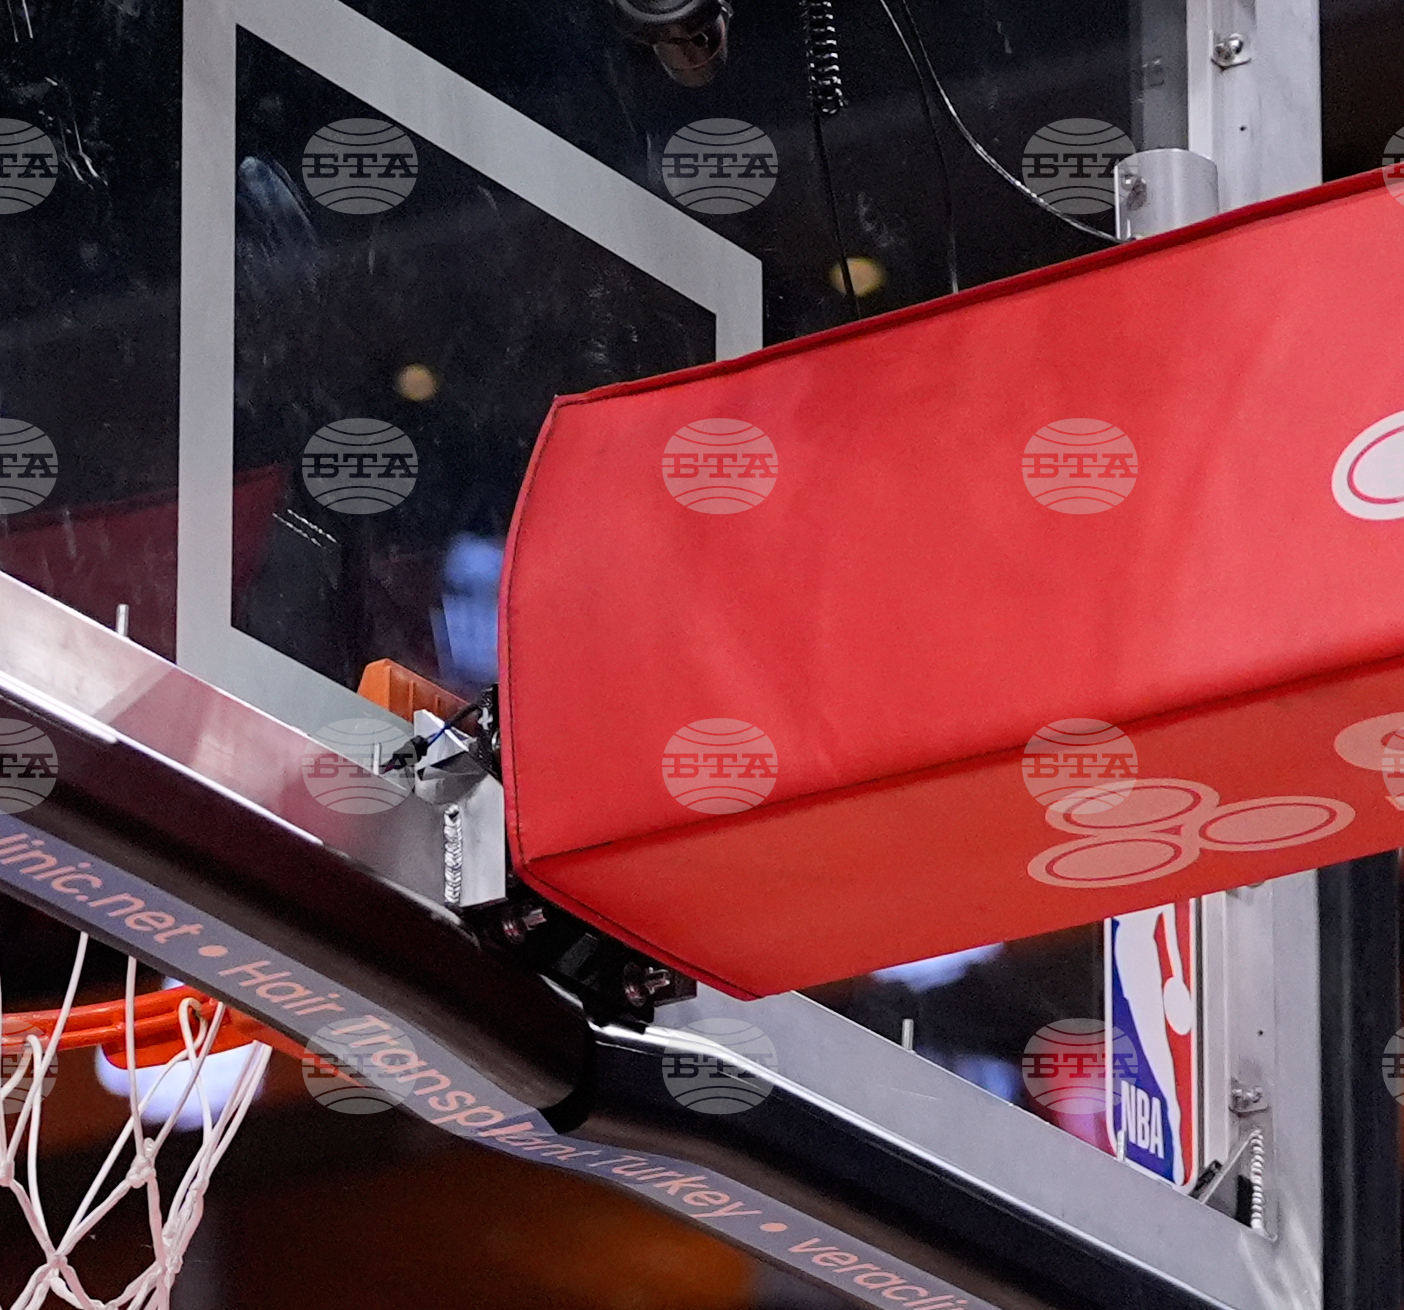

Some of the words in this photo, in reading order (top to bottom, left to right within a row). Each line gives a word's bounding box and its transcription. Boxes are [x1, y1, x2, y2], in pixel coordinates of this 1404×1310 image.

[217, 960, 346, 1017] Hair
[330, 1013, 602, 1162] Transplant
[586, 1153, 763, 1219] Turkey
[1121, 1079, 1165, 1159] NBA
